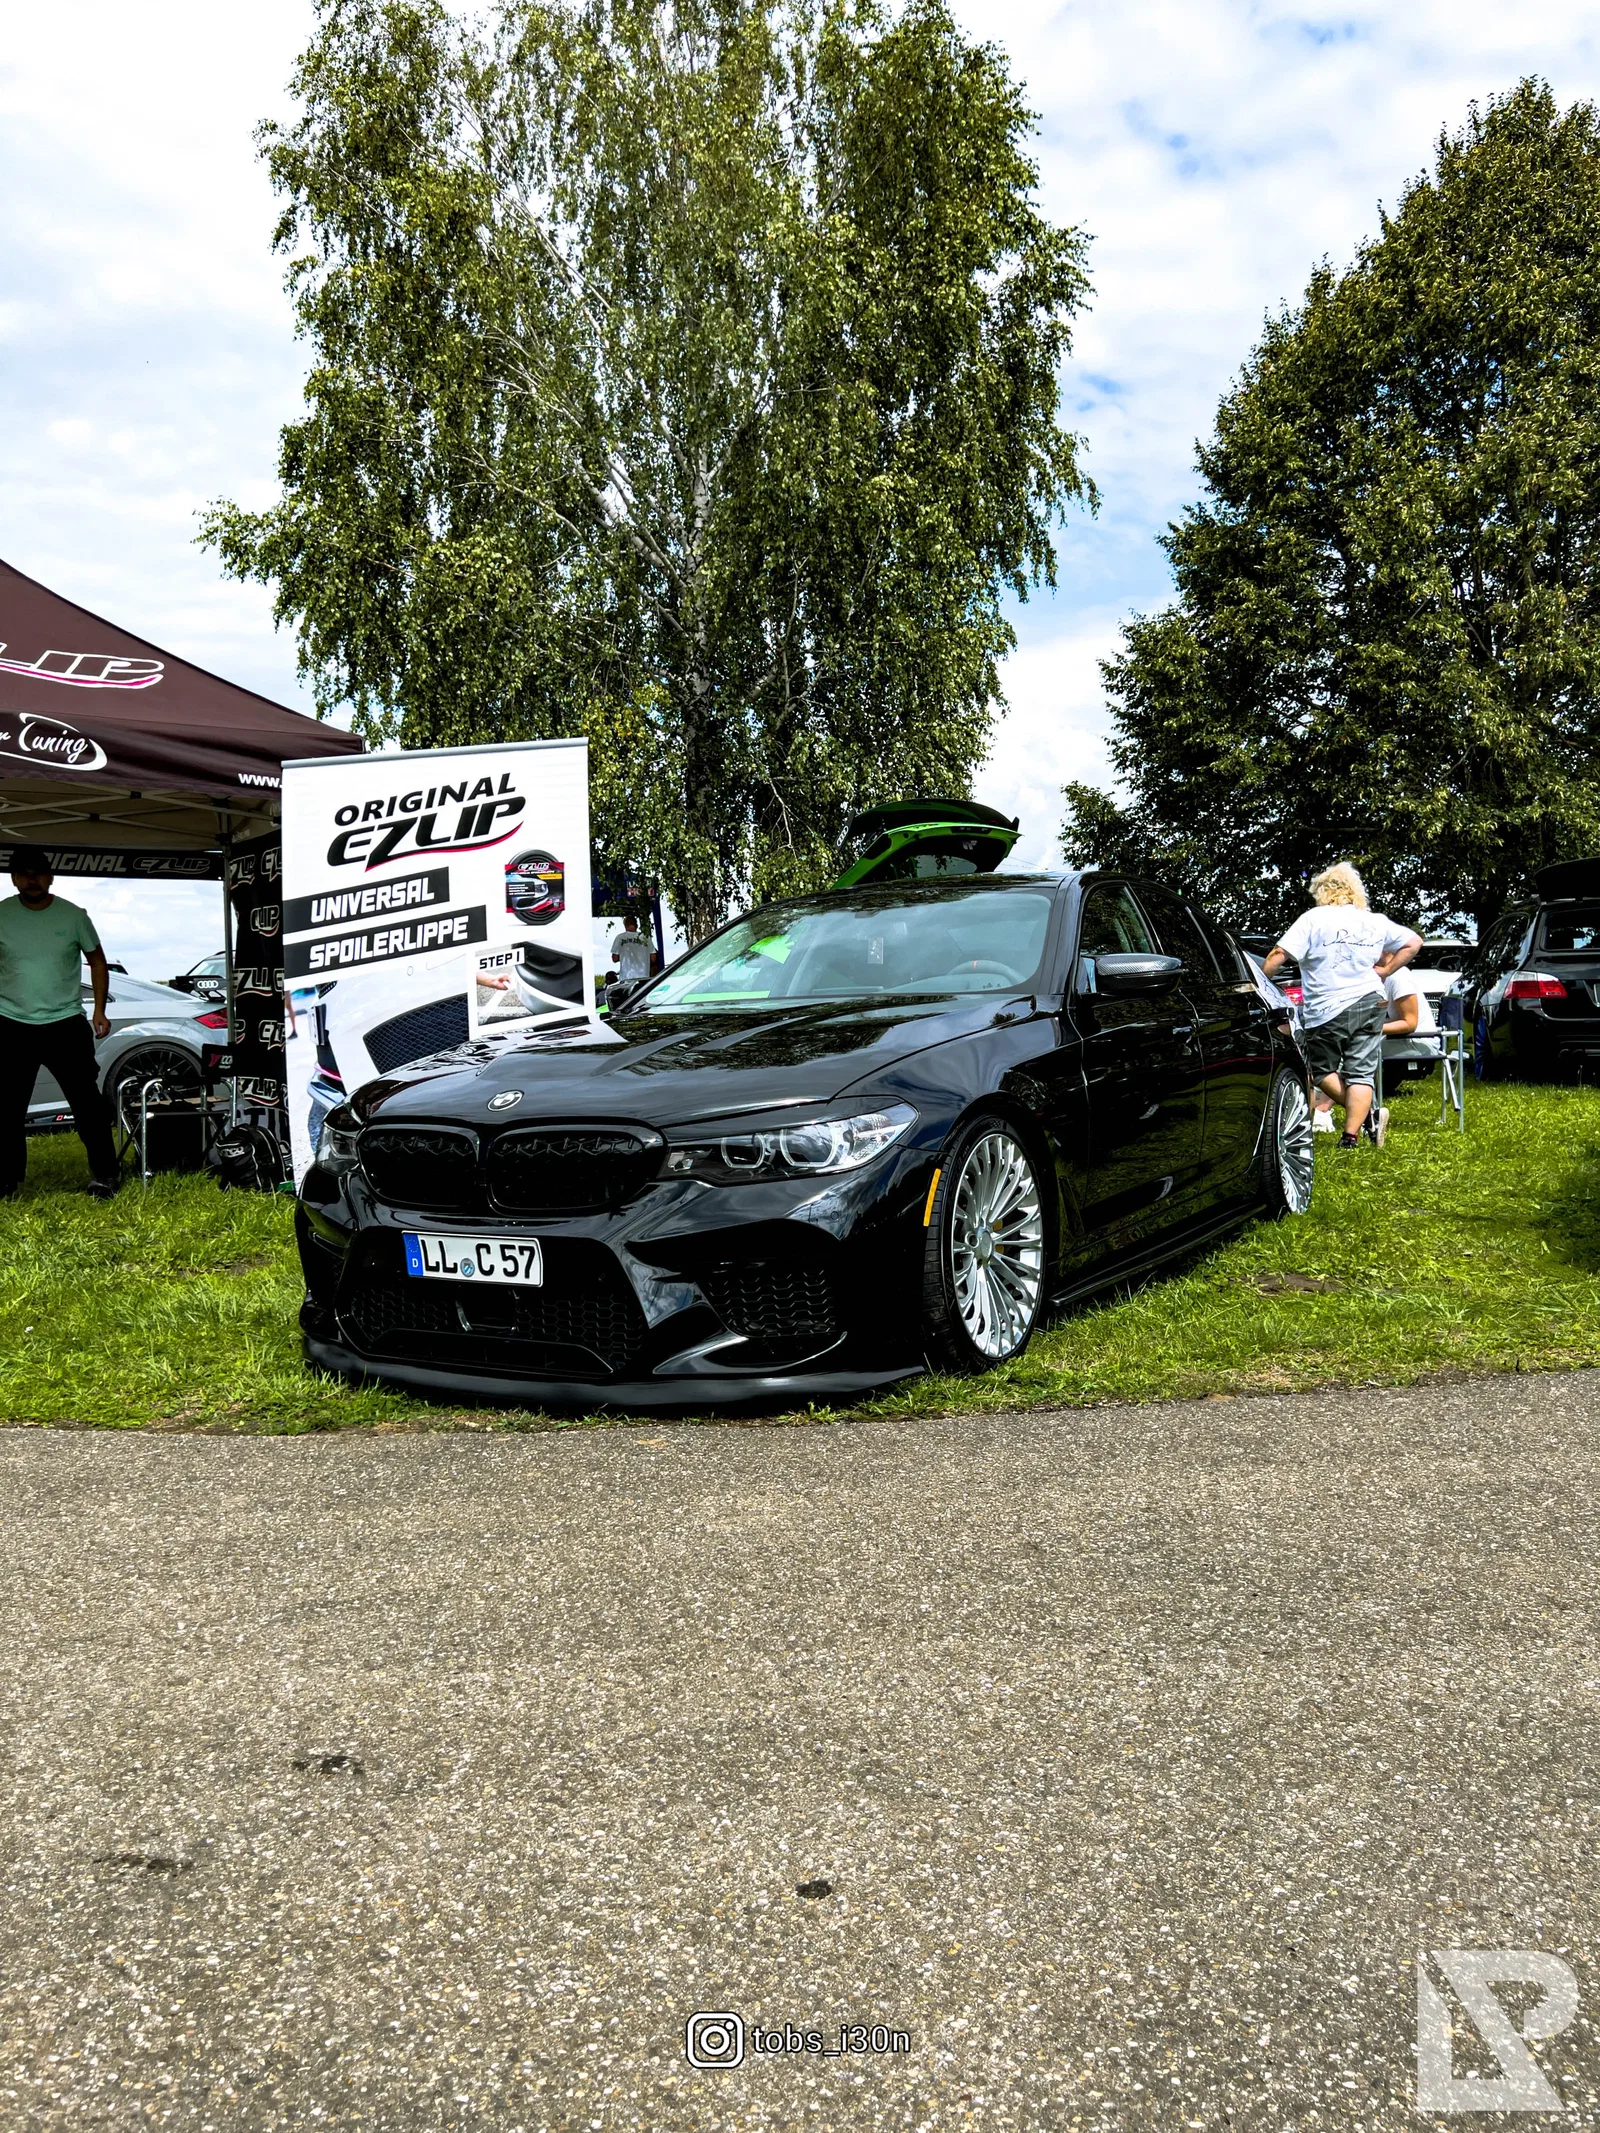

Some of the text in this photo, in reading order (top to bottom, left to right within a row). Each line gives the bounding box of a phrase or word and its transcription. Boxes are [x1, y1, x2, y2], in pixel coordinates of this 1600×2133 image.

[18, 721, 88, 764] Tuning
[334, 772, 516, 827] ORIGINAL
[326, 795, 526, 873] EZLIP
[132, 856, 210, 875] EZLIP
[310, 877, 435, 924] UNIVERSAL
[308, 915, 469, 970] SPOILERLIPPE
[479, 952, 513, 970] STEP
[411, 1257, 419, 1269] D
[420, 1239, 536, 1280] LL C 57
